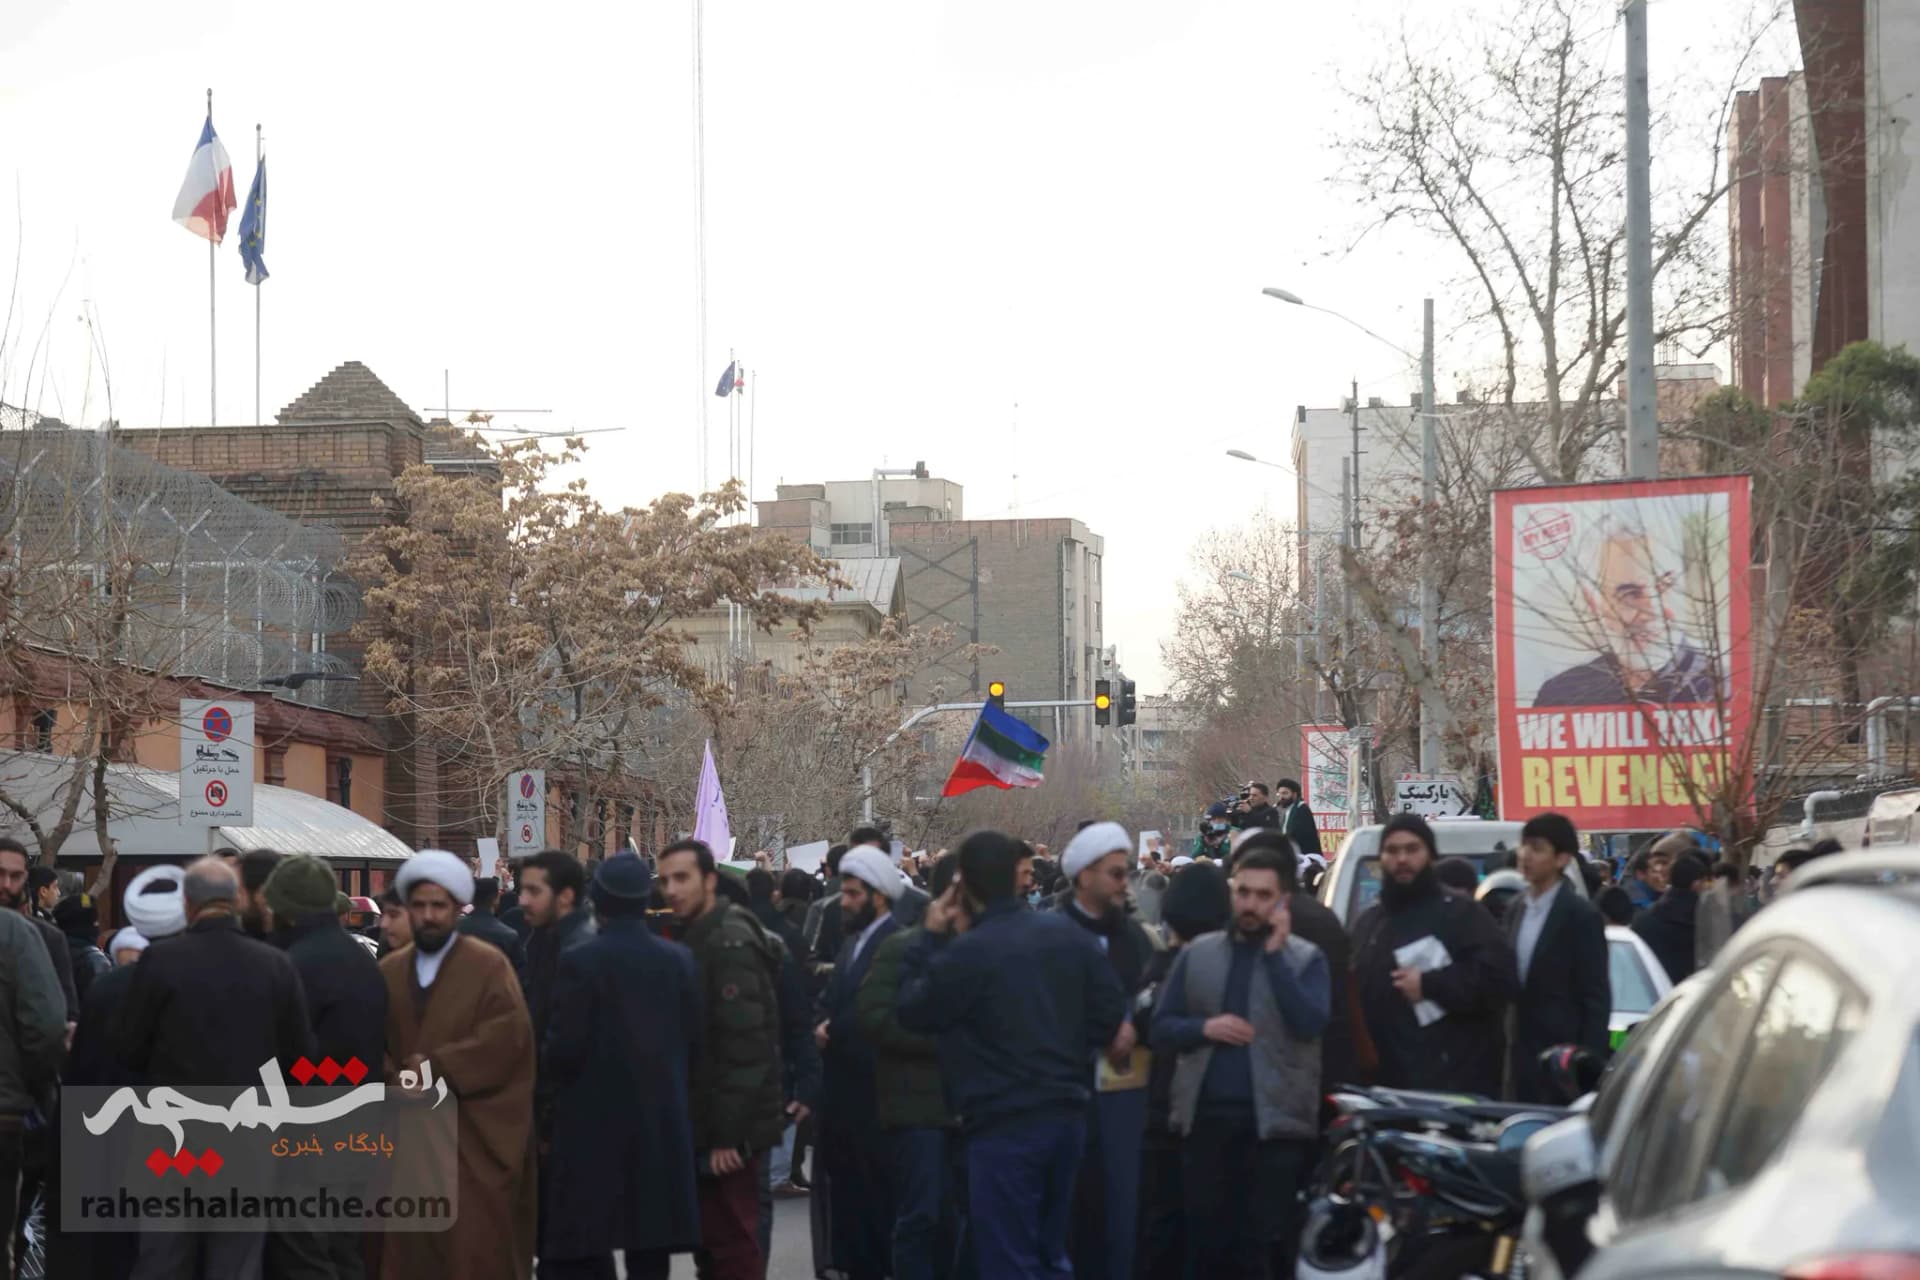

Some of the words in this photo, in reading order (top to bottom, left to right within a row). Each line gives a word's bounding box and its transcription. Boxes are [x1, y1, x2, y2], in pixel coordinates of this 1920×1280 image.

[1516, 713, 1567, 750] WE
[1571, 710, 1649, 749] WILL
[1653, 708, 1732, 747] TAKE
[1399, 784, 1449, 806] پارکینگ
